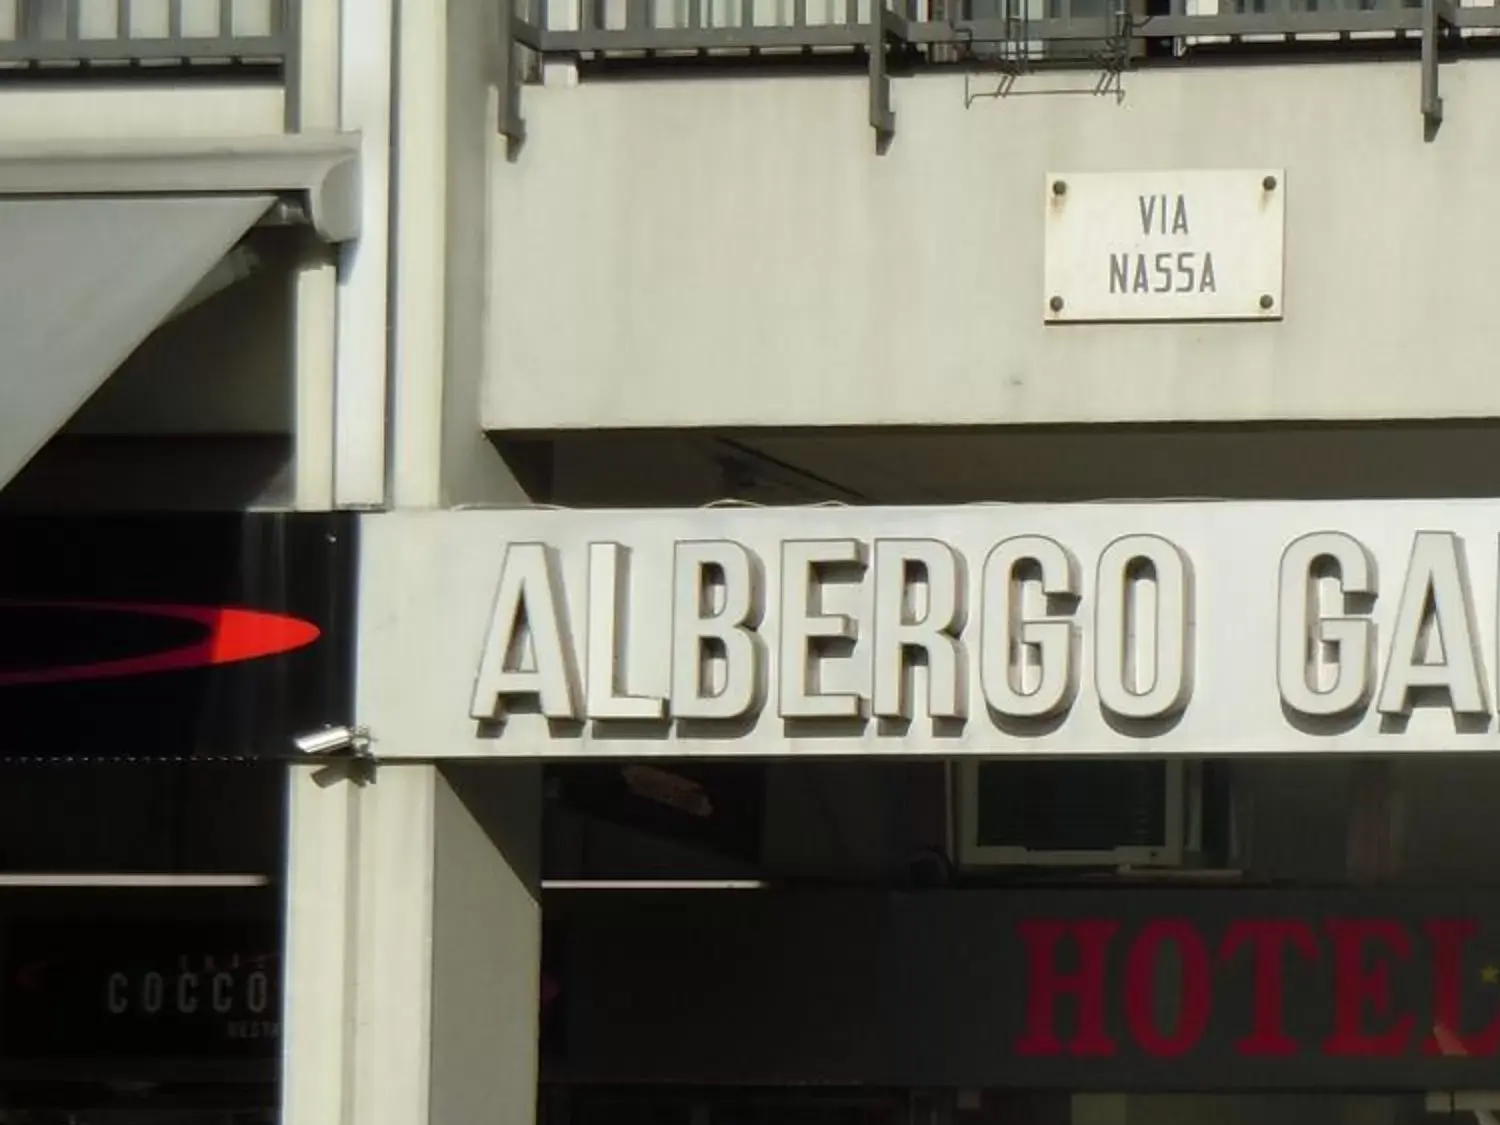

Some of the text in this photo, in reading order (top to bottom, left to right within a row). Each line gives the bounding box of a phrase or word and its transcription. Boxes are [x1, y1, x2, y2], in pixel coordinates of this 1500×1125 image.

[1138, 194, 1189, 235] VIA
[1109, 251, 1216, 293] NASSA
[470, 533, 1194, 724] ALBERGO
